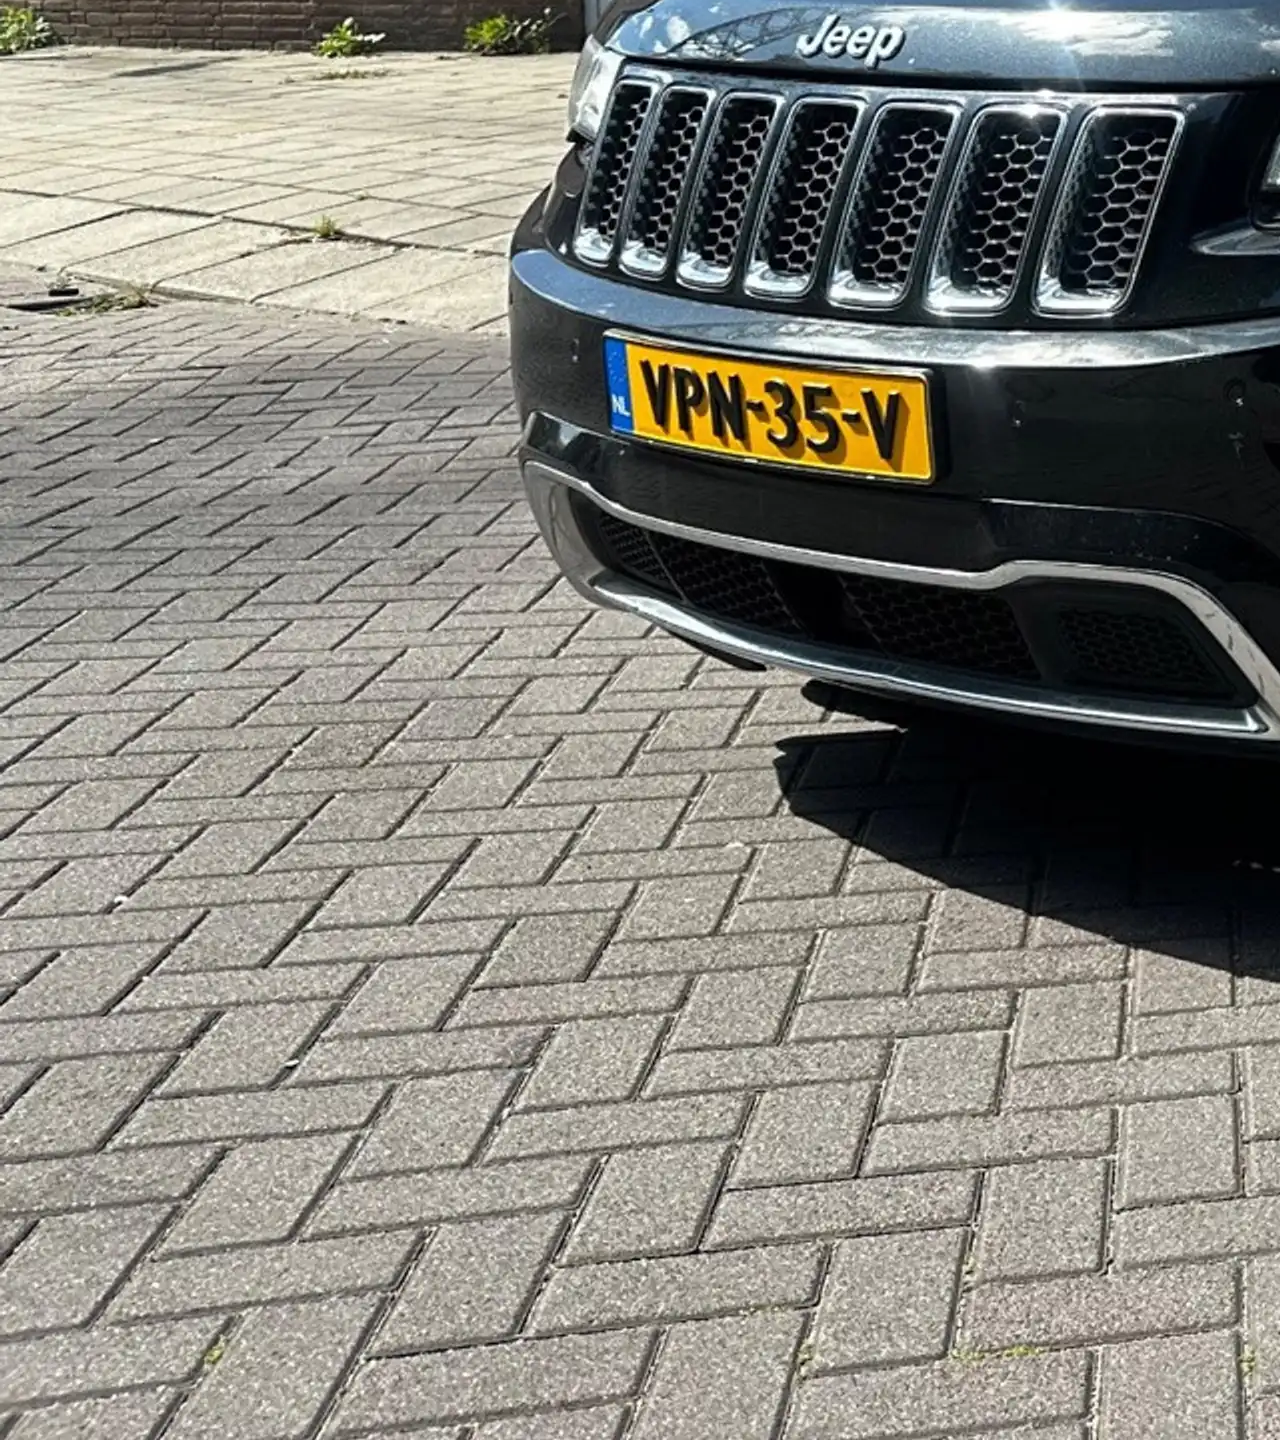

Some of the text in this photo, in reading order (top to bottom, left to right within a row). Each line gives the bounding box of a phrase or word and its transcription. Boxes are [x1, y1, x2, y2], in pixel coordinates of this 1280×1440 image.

[796, 13, 906, 70] Jeep
[612, 394, 631, 417] NL
[639, 358, 901, 461] VPN-35-V
